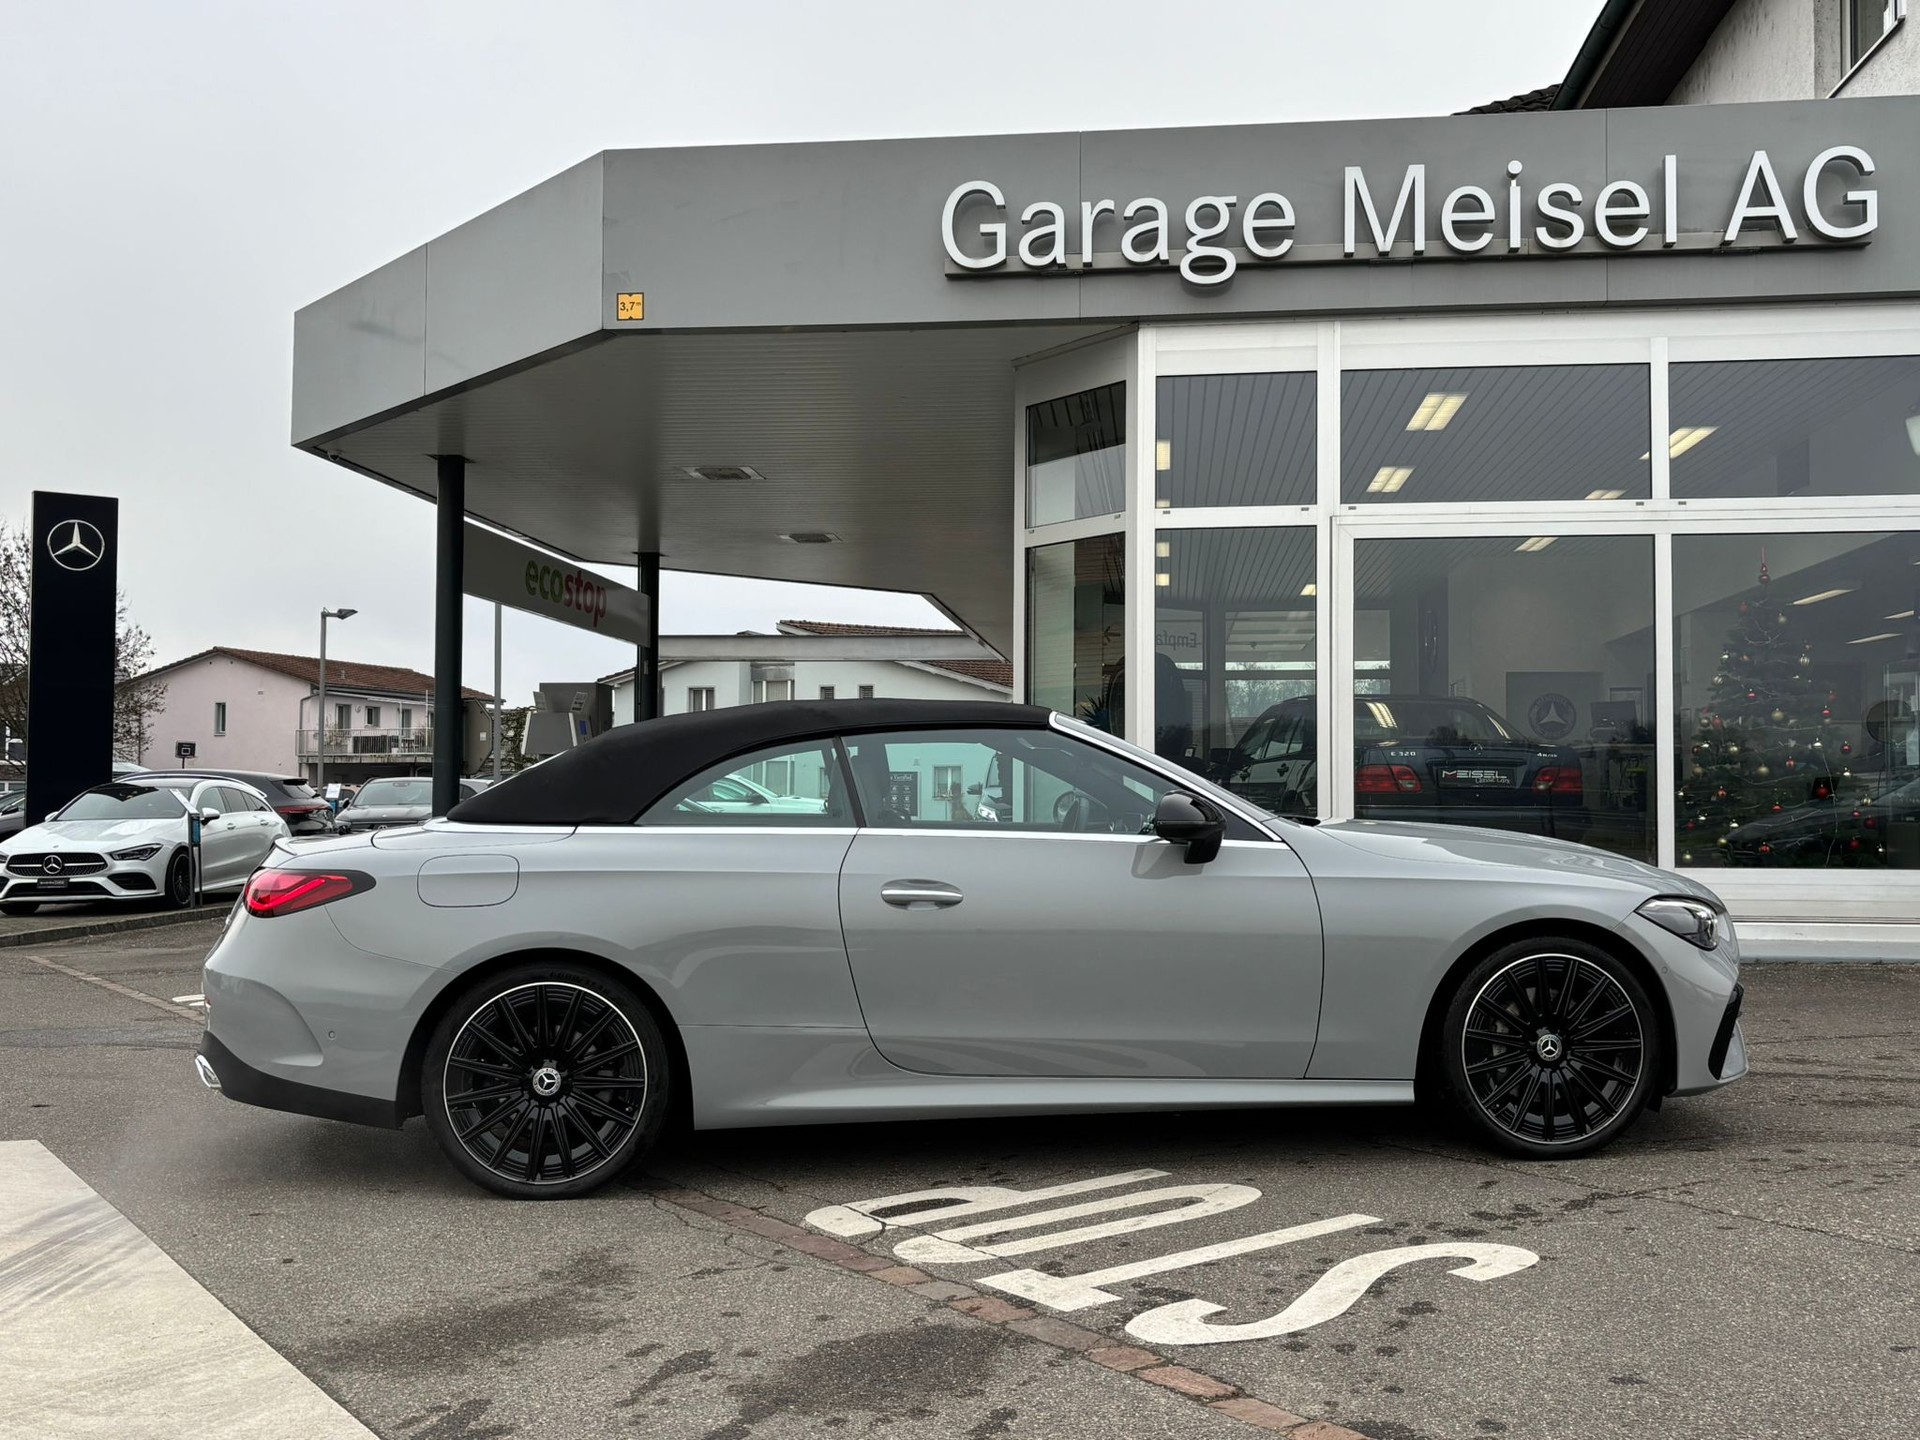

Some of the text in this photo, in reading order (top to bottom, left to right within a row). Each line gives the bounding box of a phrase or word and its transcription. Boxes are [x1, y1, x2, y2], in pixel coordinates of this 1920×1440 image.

[941, 145, 1879, 285] Garage Meisel AG
[525, 560, 607, 627] ecostop
[1441, 769, 1508, 779] MEISEL
[804, 1168, 1540, 1346] STOP
